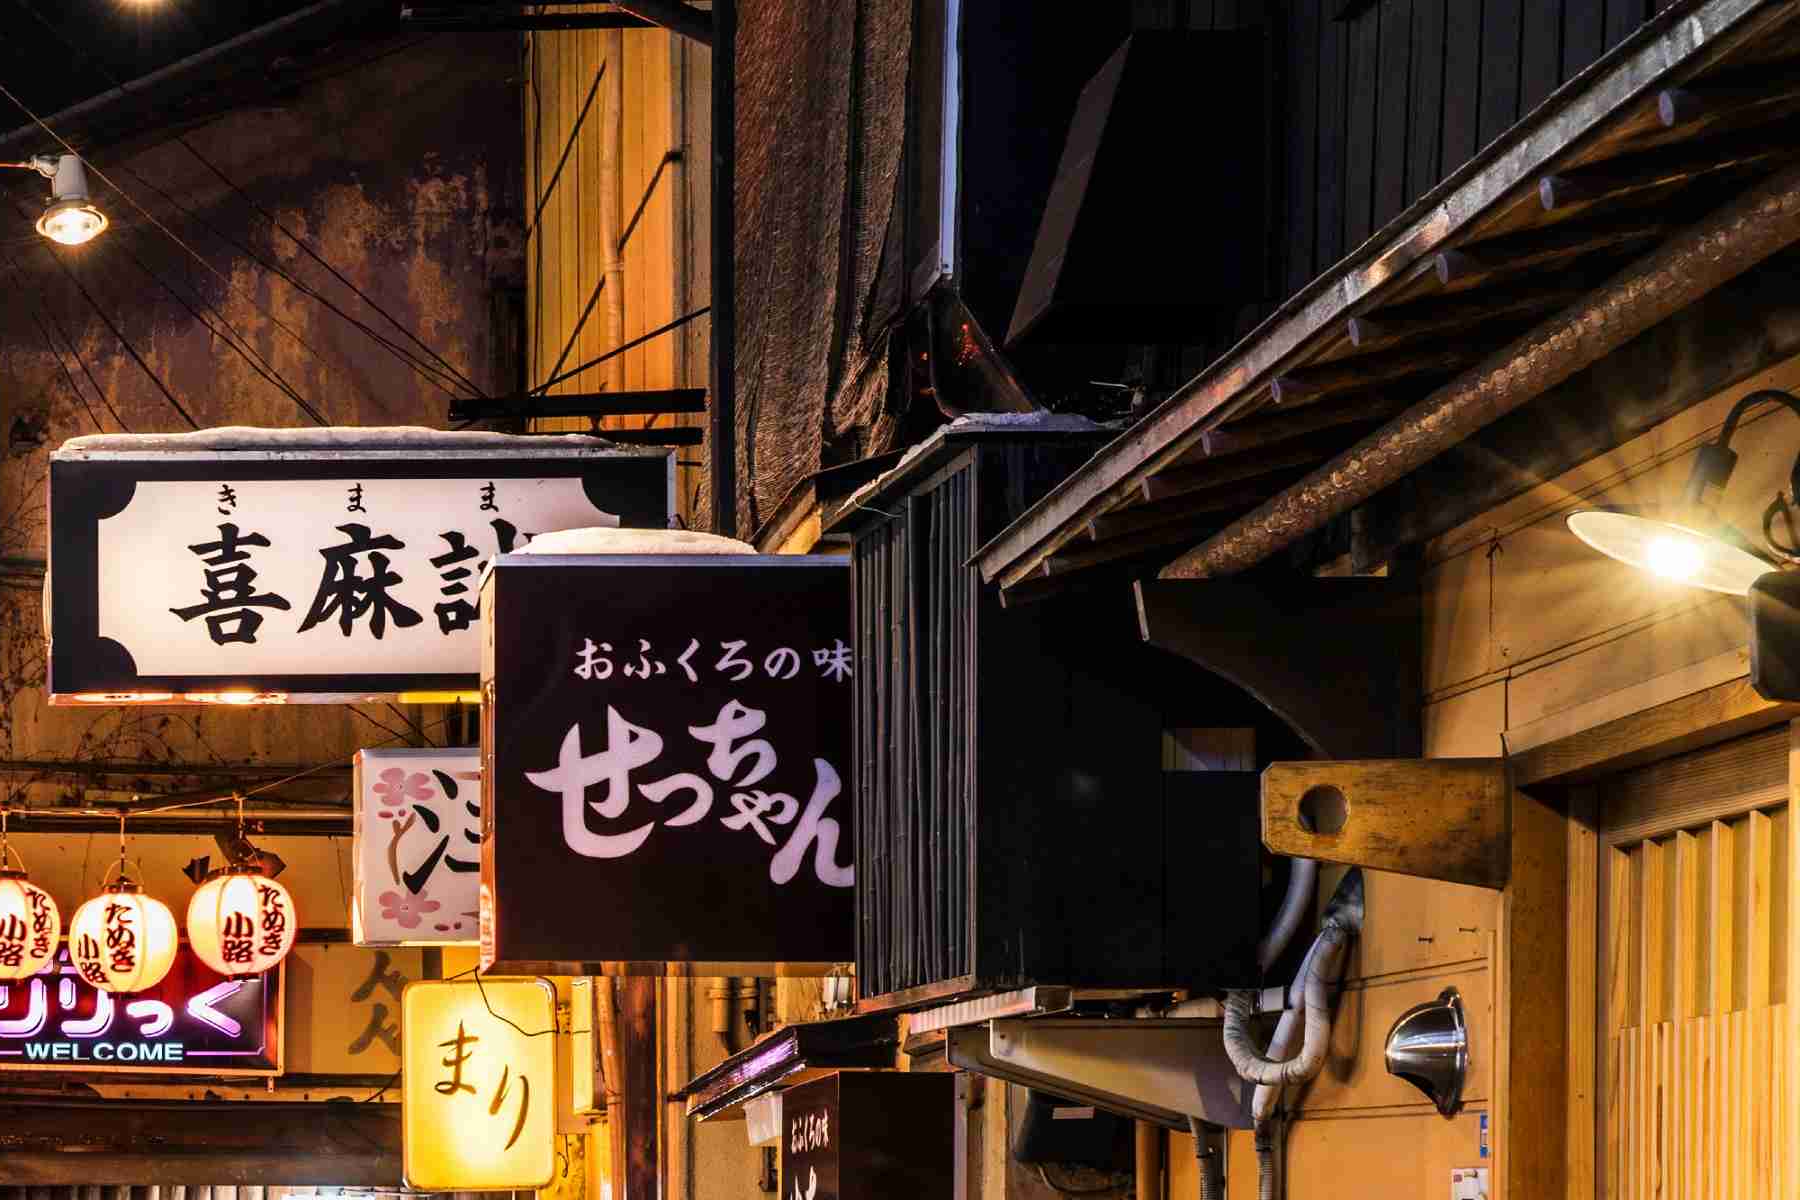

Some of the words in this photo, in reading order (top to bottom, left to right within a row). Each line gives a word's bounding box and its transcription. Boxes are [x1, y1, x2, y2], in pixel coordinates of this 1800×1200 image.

[573, 637, 854, 683] おふくろの味
[525, 698, 855, 888] せっちゃん
[77, 933, 111, 985] 小路
[222, 910, 255, 964] 小路
[25, 1041, 184, 1063] WELCOME
[434, 1018, 530, 1152] まり
